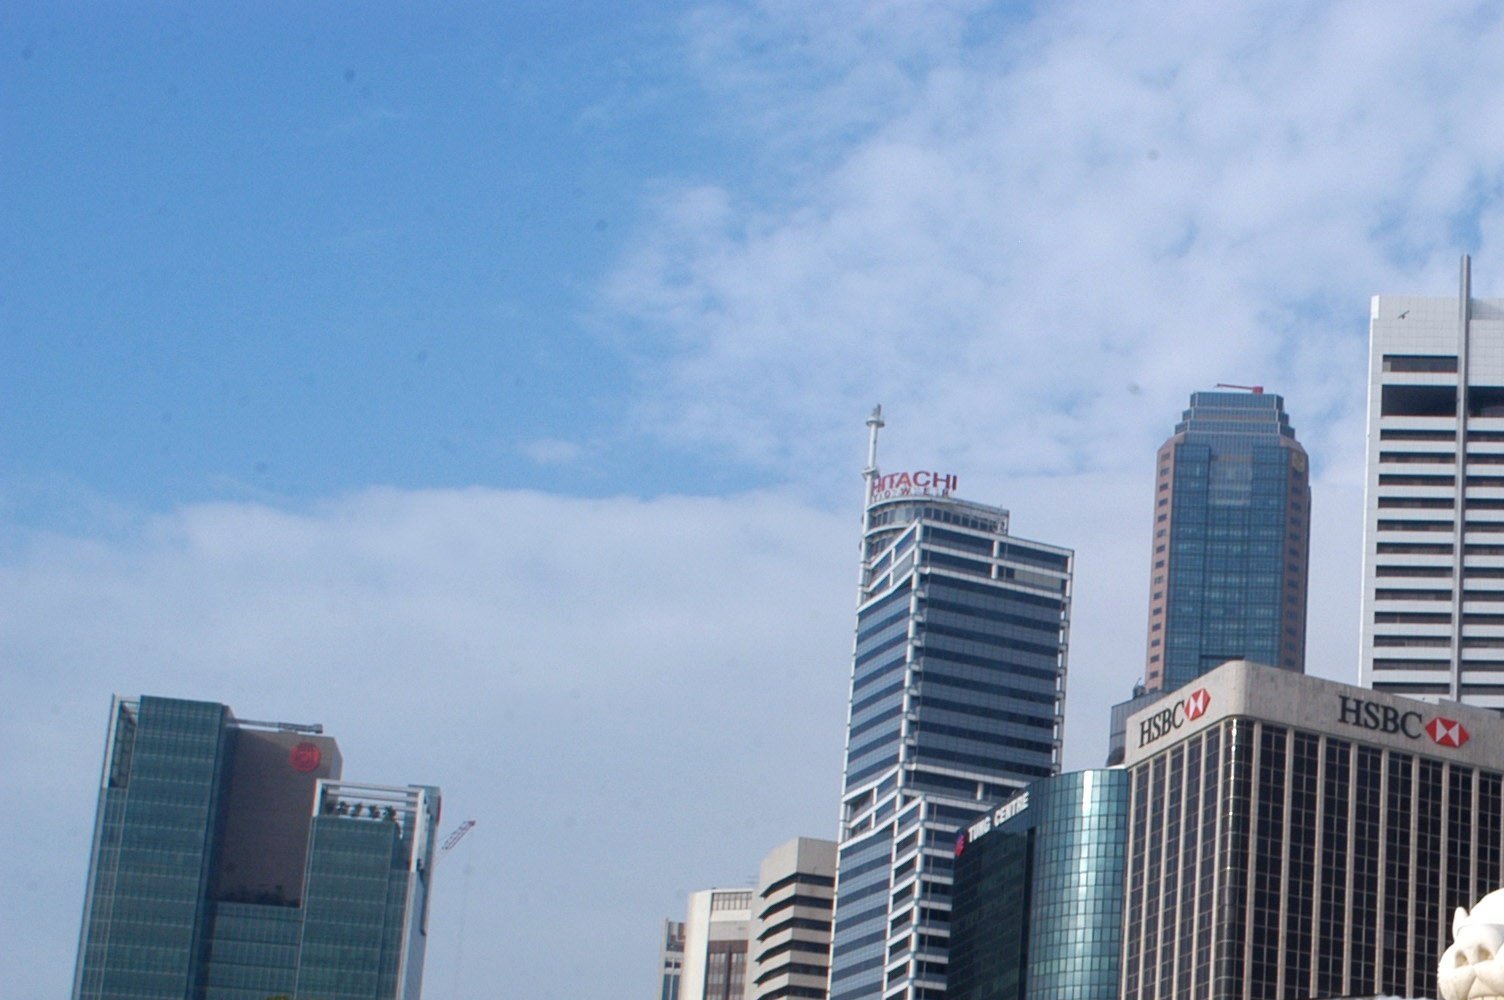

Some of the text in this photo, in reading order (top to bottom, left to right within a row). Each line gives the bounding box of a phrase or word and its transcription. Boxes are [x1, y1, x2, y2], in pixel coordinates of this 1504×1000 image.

[872, 471, 958, 495] HITACHI
[1138, 699, 1185, 749] HSBC
[1338, 695, 1423, 740] HSBC
[994, 791, 1029, 827] CENTRE
